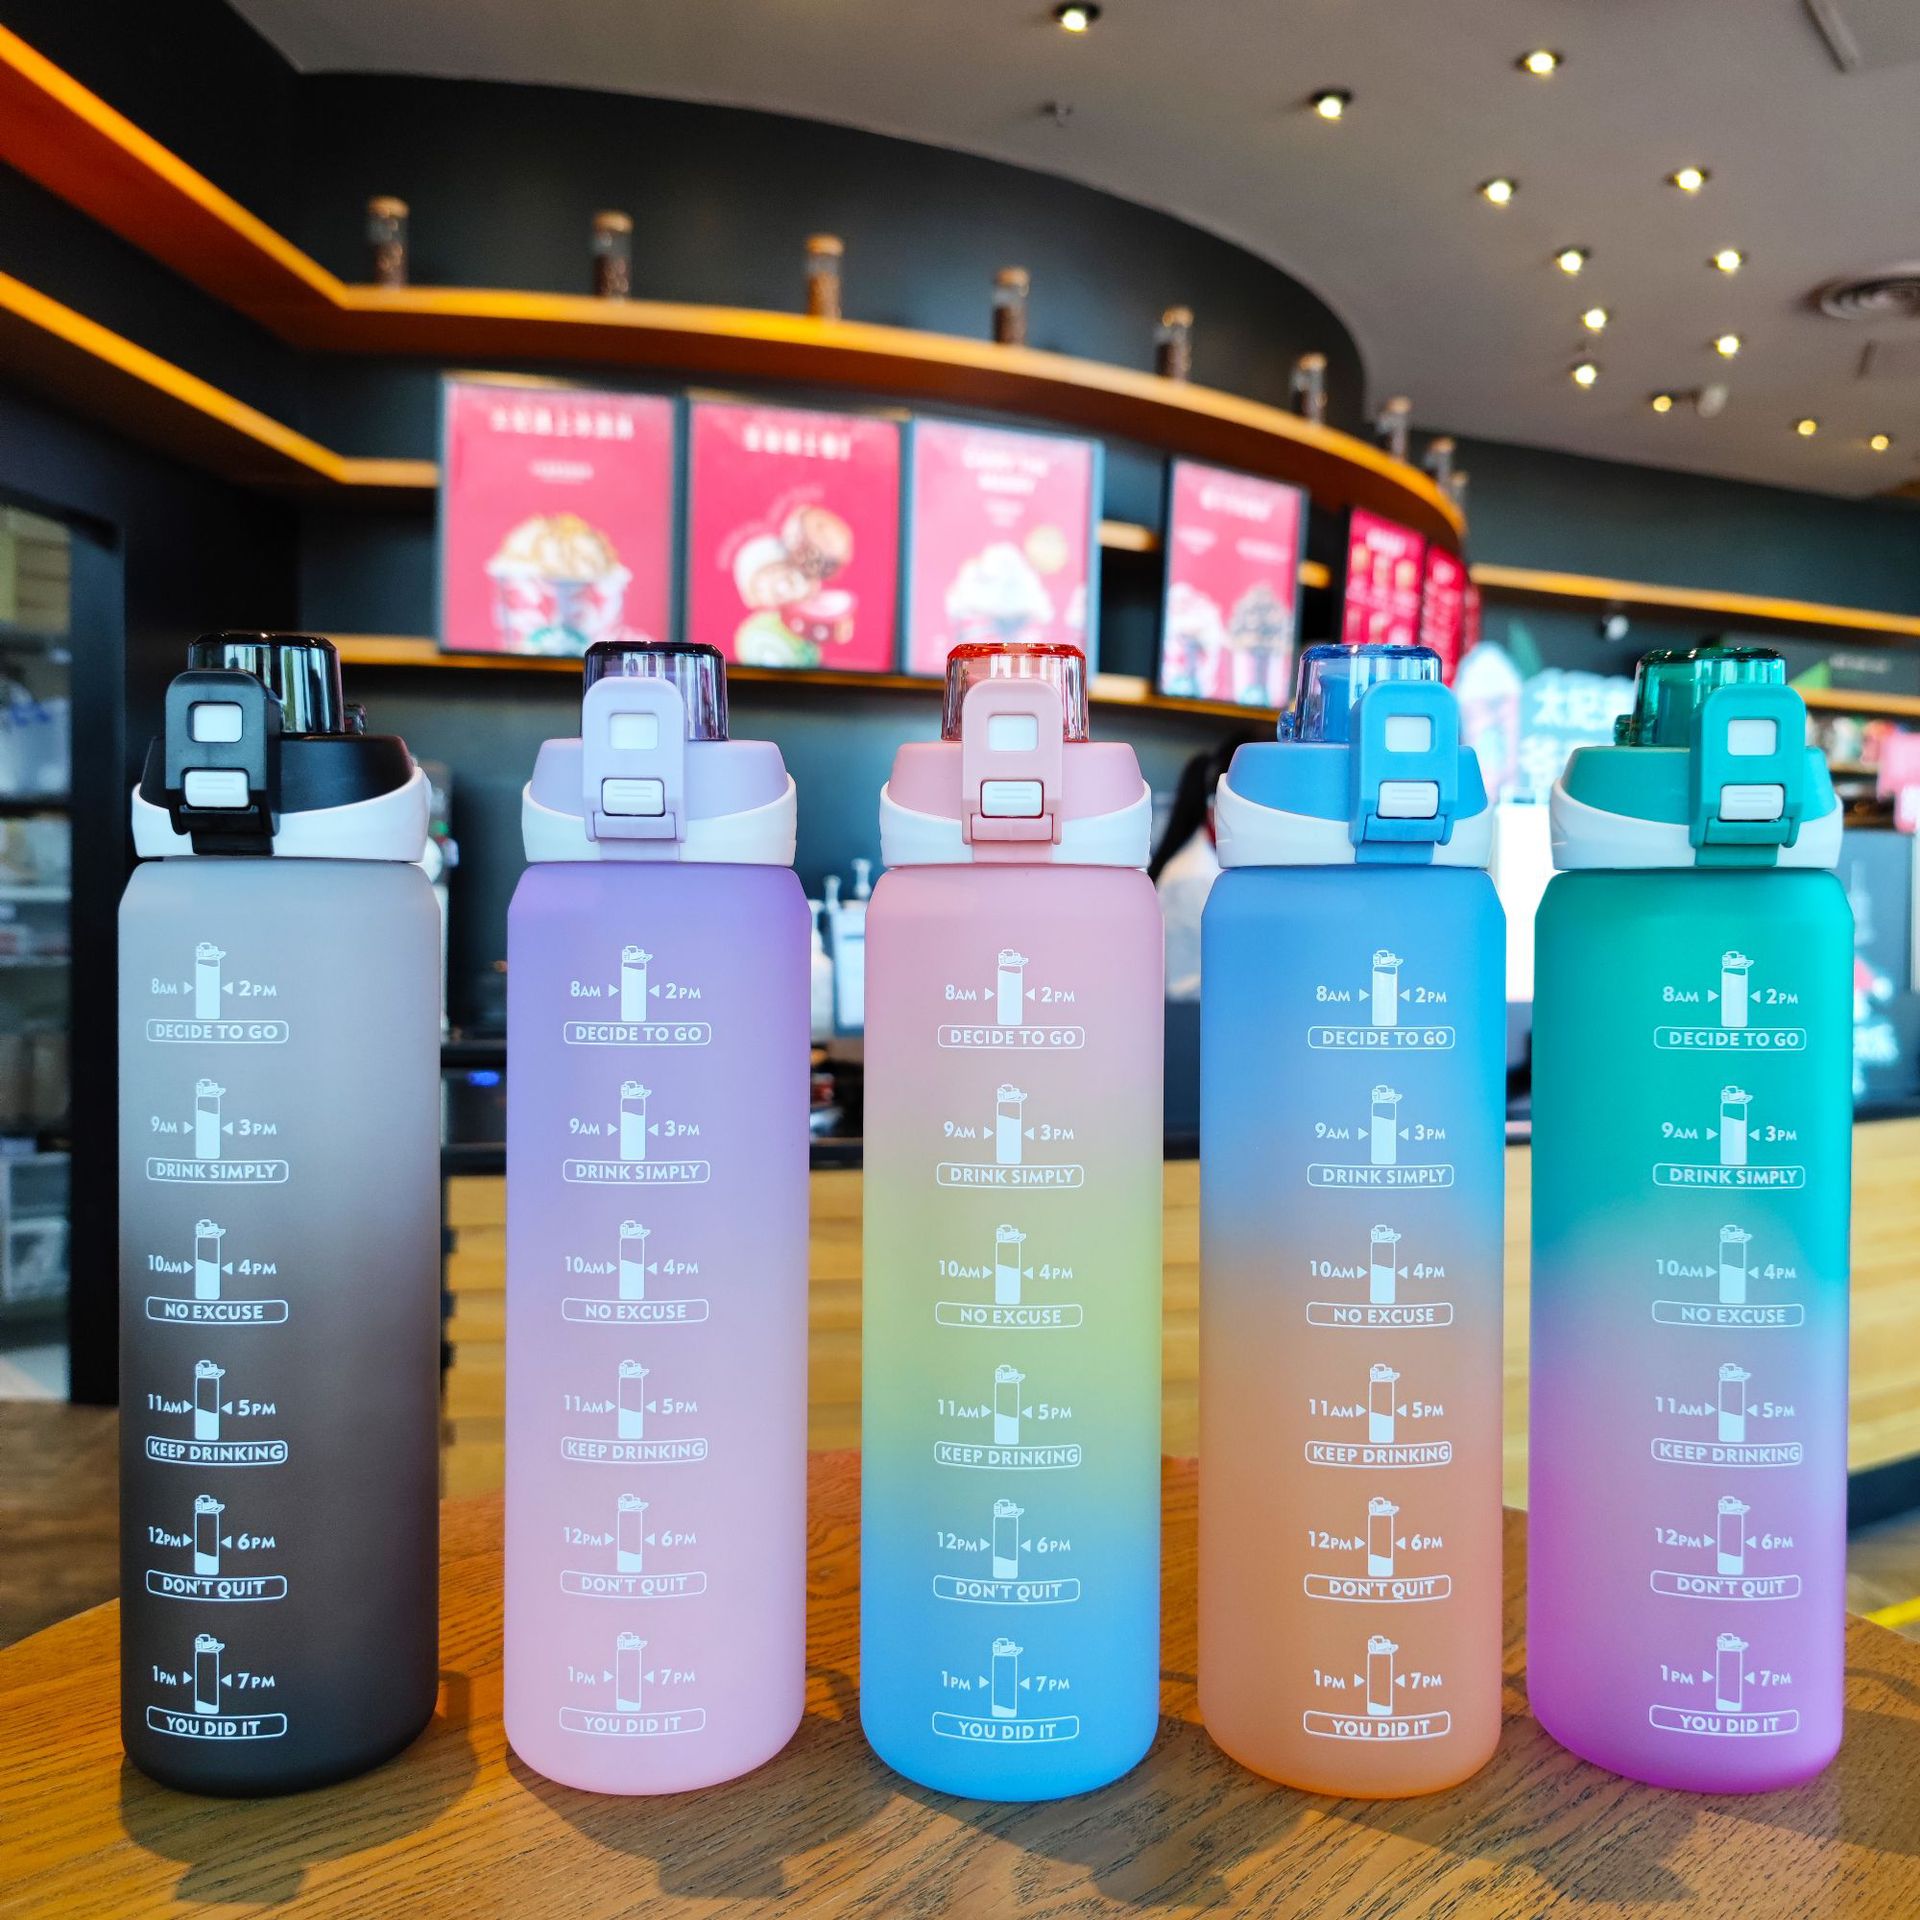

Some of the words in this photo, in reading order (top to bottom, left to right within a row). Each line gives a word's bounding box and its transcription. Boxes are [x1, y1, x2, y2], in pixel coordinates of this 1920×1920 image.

[151, 978, 178, 995] 8AM
[570, 980, 601, 998] 8AM
[944, 984, 977, 1002] 8AM
[1315, 985, 1351, 1002] 8AM
[1662, 986, 1699, 1003] 8AM
[155, 1024, 213, 1039] DECIDE
[216, 1025, 242, 1039] TO
[248, 1025, 278, 1040] GO
[575, 1025, 638, 1041] DECIDE
[642, 1026, 670, 1042] TO
[673, 1026, 702, 1042] GO
[950, 1029, 1015, 1045] DECIDE
[1021, 1030, 1046, 1046] TO
[1050, 1030, 1076, 1046] GO
[1322, 1030, 1390, 1046] DECIDE
[1393, 1031, 1419, 1046] TO
[1423, 1031, 1448, 1046] GO
[1669, 1031, 1740, 1047] DECIDE
[1744, 1032, 1770, 1047] TO
[1774, 1032, 1799, 1047] GO
[150, 1116, 178, 1134] 9AM
[569, 1118, 601, 1136] 9AM
[943, 1120, 976, 1139] 9AM
[1314, 1122, 1350, 1140] 9AM
[1661, 1121, 1699, 1140] 9AM
[156, 1162, 206, 1178] DRINK
[210, 1163, 277, 1179] SIMPLY
[575, 1163, 630, 1179] DRINK
[634, 1164, 701, 1180] SIMPLY
[950, 1167, 1007, 1184] DRINK
[1011, 1168, 1075, 1184] SIMPLY
[1322, 1168, 1382, 1184] DRINK
[1385, 1168, 1446, 1184] SIMPLY
[1669, 1167, 1732, 1184] DRINK
[1735, 1169, 1798, 1185] SIMPLY
[147, 1255, 183, 1272] 10AM
[564, 1255, 606, 1275] 10AM
[939, 1259, 981, 1278] 10AM
[1310, 1259, 1355, 1279] 10AM
[1656, 1258, 1704, 1279] 10AM
[164, 1302, 189, 1319] NO
[192, 1304, 264, 1320] EXCUSE
[584, 1303, 612, 1319] NO
[616, 1304, 687, 1319] EXCUSE
[960, 1308, 988, 1324] NO
[993, 1309, 1062, 1325] EXCUSE
[1333, 1308, 1362, 1323] NO
[1367, 1308, 1435, 1324] EXCUSE
[1681, 1307, 1711, 1323] NO
[1716, 1308, 1786, 1324] EXCUSE
[147, 1393, 183, 1413] 11AM
[563, 1394, 604, 1414] 11AM
[937, 1399, 980, 1419] 11AM
[1308, 1398, 1354, 1418] 11AM
[1655, 1396, 1703, 1417] 11AM
[150, 1441, 185, 1459] KEEP
[189, 1444, 284, 1461] DRINKING
[567, 1440, 608, 1459] KEEP
[612, 1443, 706, 1460] DRINKING
[941, 1445, 983, 1464] KEEP
[988, 1449, 1079, 1466] DRINKING
[1313, 1444, 1358, 1462] KEEP
[1362, 1446, 1450, 1464] DRINKING
[1659, 1442, 1707, 1461] KEEP
[1711, 1445, 1800, 1463] DRINKING
[147, 1526, 182, 1547] 12PM
[563, 1526, 603, 1546] 12PM
[937, 1531, 978, 1552] 12PM
[1308, 1530, 1353, 1551] 12PM
[1655, 1526, 1702, 1549] 12PM
[162, 1576, 213, 1596] DON'T
[217, 1579, 266, 1599] QUIT
[581, 1576, 637, 1593] DON'T
[640, 1576, 688, 1597] QUIT
[955, 1581, 1012, 1600] DON'T
[1016, 1583, 1063, 1602] QUIT
[1328, 1579, 1388, 1597] DON'T
[1391, 1580, 1435, 1599] QUIT
[1676, 1577, 1738, 1595] DON'T
[1742, 1578, 1786, 1598] QUIT
[151, 1665, 177, 1686] 1PM
[567, 1666, 596, 1686] 1PM
[941, 1670, 971, 1691] 1PM
[1313, 1668, 1346, 1689] 1PM
[1660, 1664, 1694, 1686] 1PM
[166, 1716, 200, 1734] YOU
[204, 1720, 237, 1736] DID
[241, 1721, 261, 1735] IT
[584, 1716, 622, 1733] YOU
[626, 1718, 660, 1734] DID
[663, 1716, 682, 1732] IT
[958, 1720, 998, 1739] YOU
[1001, 1723, 1035, 1740] DID
[1039, 1722, 1057, 1739] IT
[1332, 1719, 1371, 1737] YOU
[1377, 1720, 1410, 1738] DID
[1413, 1719, 1430, 1735] IT
[1679, 1713, 1721, 1733] YOU
[1725, 1717, 1759, 1734] DID
[1763, 1717, 1779, 1733] IT
